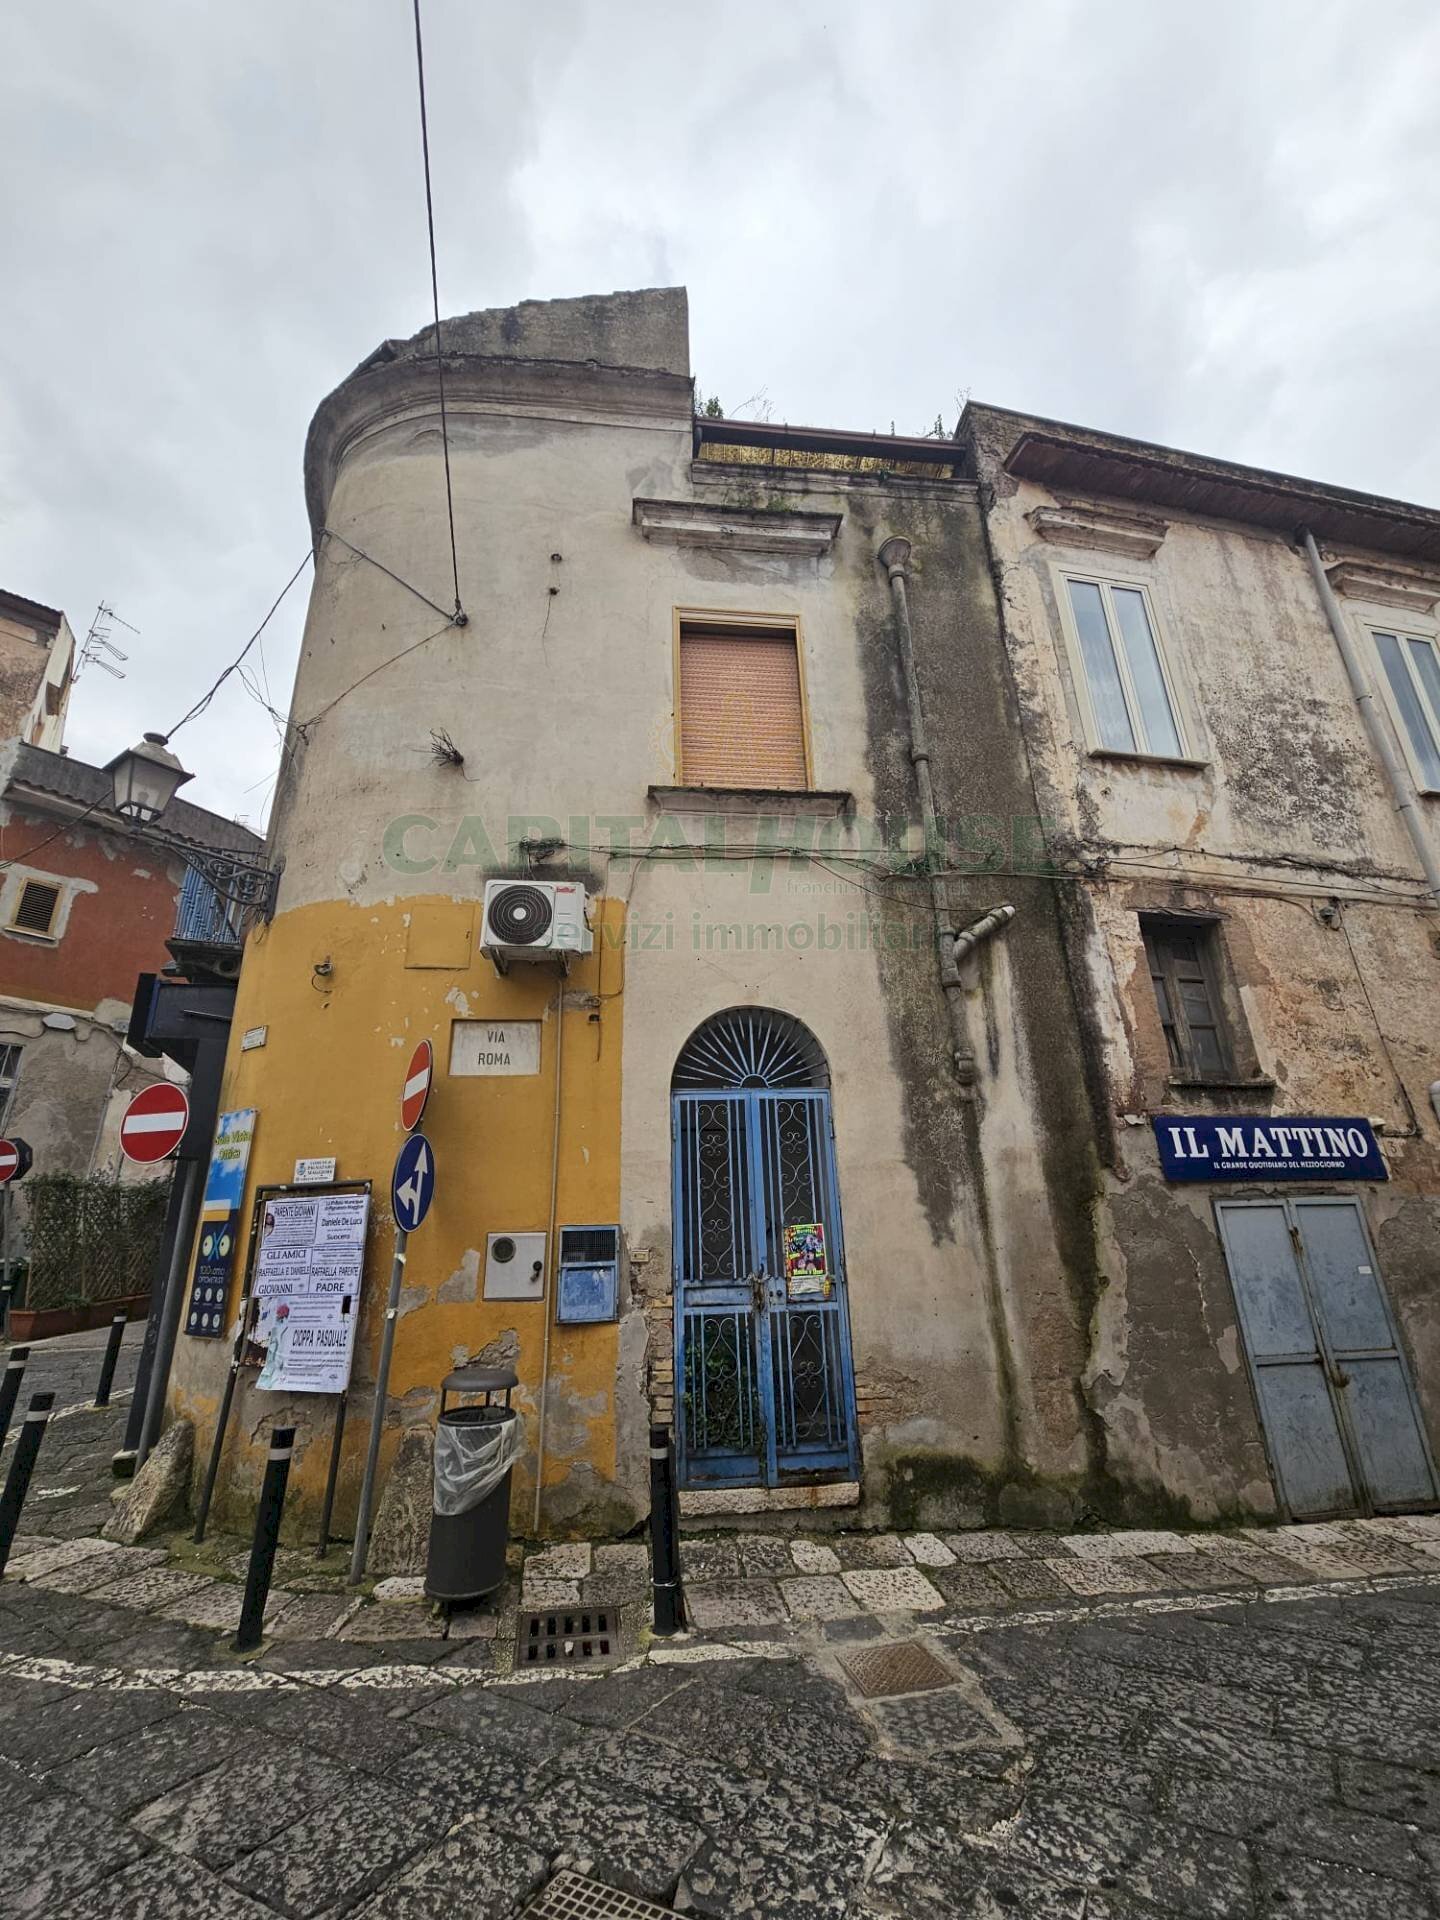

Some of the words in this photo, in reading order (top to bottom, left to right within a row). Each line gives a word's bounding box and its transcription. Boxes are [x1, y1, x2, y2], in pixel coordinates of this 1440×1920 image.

[487, 1030, 505, 1043] VIA
[478, 1052, 511, 1066] ROMA
[1168, 1127, 1210, 1158] IL
[1215, 1127, 1368, 1158] MATTINO
[1213, 1161, 1220, 1169] IL
[1221, 1161, 1248, 1169] GRANDE
[1248, 1161, 1288, 1169] QUOTIDIANO
[266, 1251, 281, 1260] GLI
[281, 1250, 307, 1259] AMICI
[258, 1284, 293, 1294] GIOVANNI
[315, 1282, 345, 1292] PADRE
[316, 1329, 348, 1347] PASQUALE
